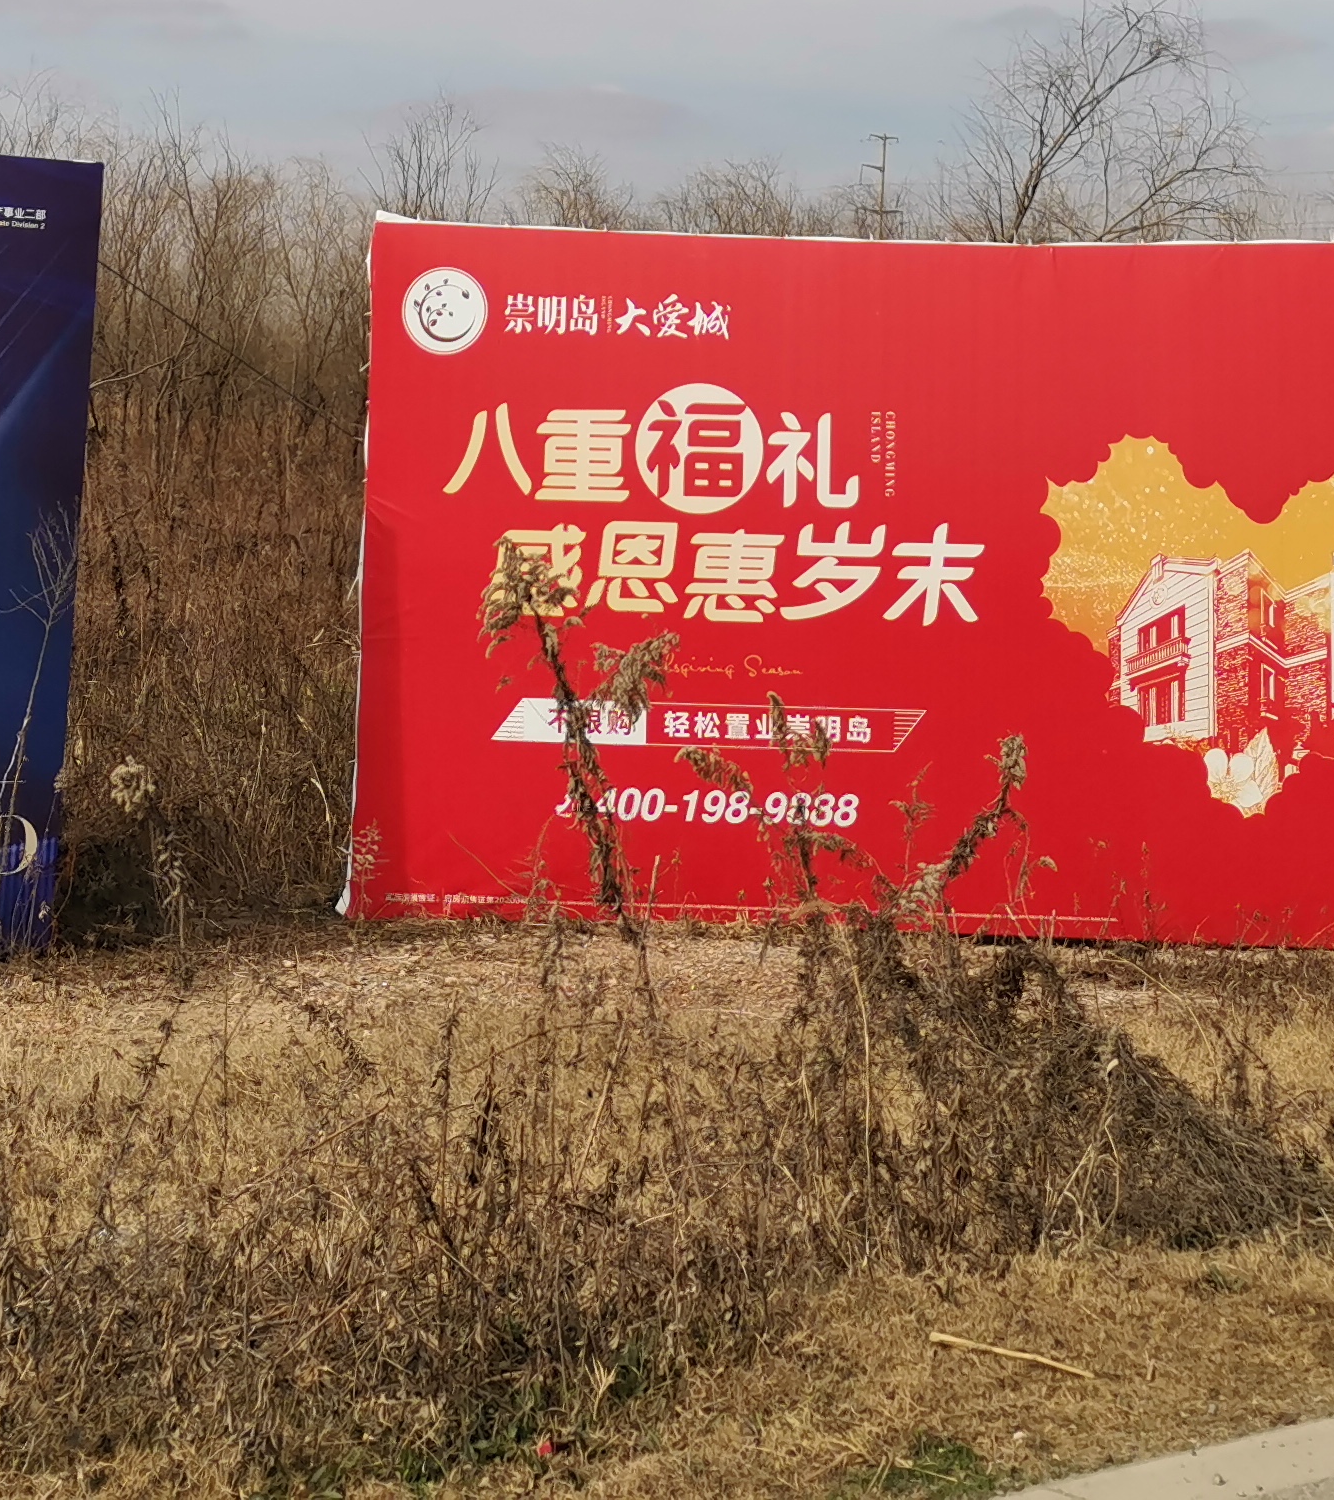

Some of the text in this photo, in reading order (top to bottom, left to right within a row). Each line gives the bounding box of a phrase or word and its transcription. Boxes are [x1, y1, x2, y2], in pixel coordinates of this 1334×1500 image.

[504, 293, 598, 335] 崇明岛
[443, 383, 859, 514] 八重福礼
[870, 411, 881, 463] ISLAND
[885, 411, 896, 497] CHONGMING
